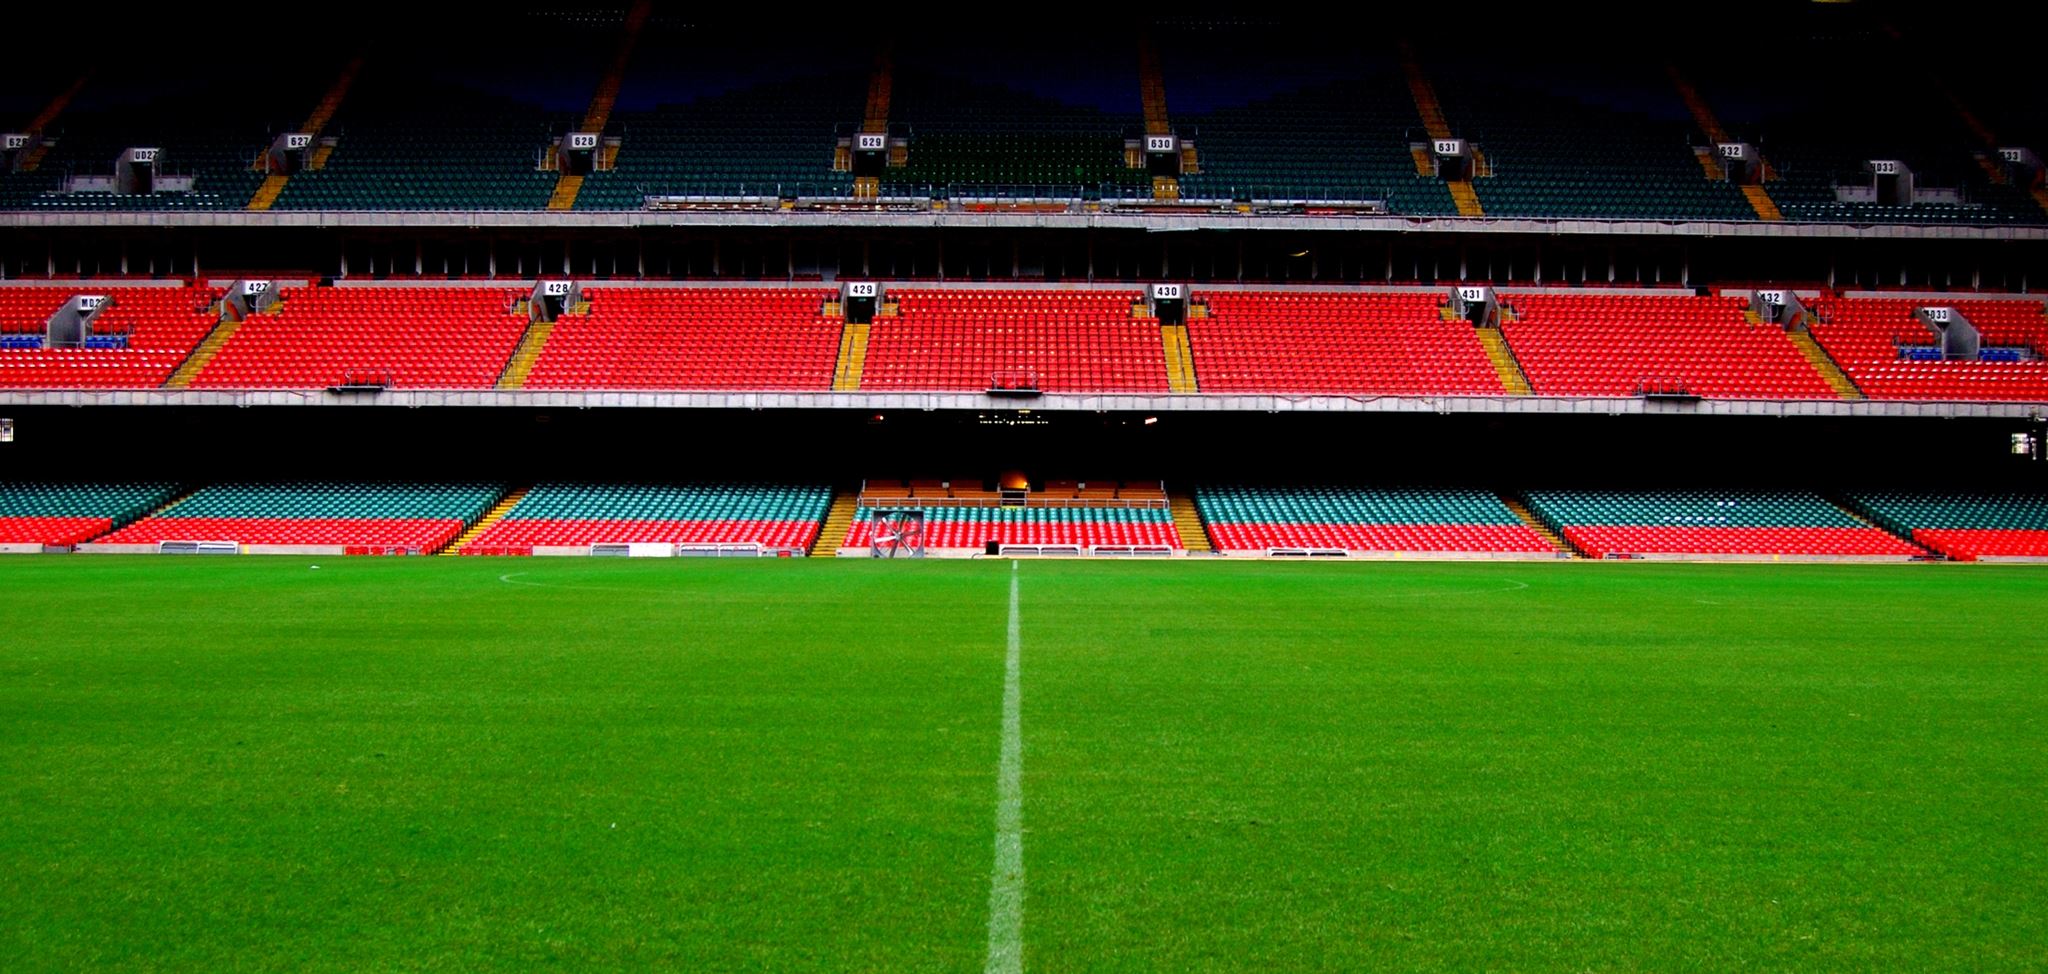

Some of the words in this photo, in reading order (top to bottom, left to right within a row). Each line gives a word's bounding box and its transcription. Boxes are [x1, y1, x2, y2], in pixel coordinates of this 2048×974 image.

[291, 137, 308, 146] 627
[574, 137, 594, 146] 628
[862, 138, 881, 147] 629
[1151, 139, 1170, 149] 630
[1438, 143, 1456, 152] 631
[1721, 147, 1739, 155] 632
[249, 283, 267, 292] 427
[549, 284, 568, 293] 428
[853, 285, 872, 294] 429
[1157, 287, 1177, 296] 430
[1463, 290, 1480, 299] 431
[81, 298, 105, 308] MD2
